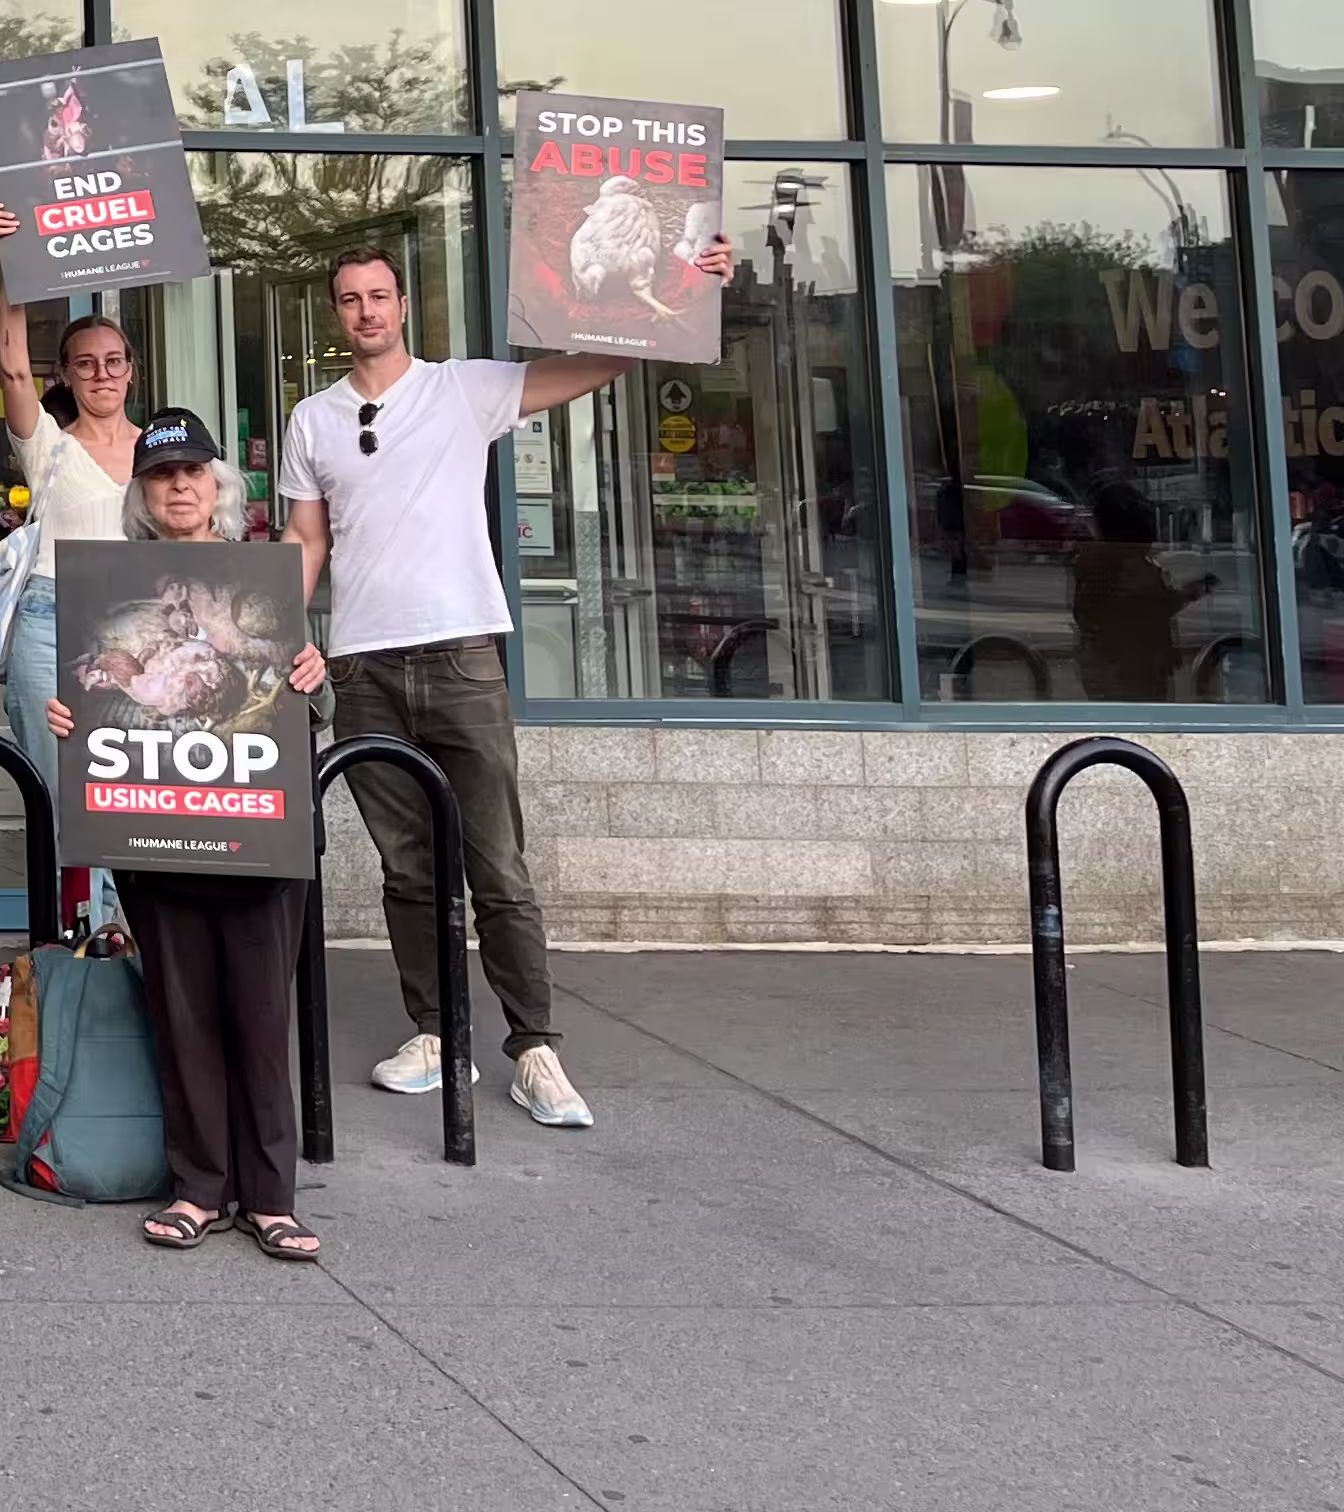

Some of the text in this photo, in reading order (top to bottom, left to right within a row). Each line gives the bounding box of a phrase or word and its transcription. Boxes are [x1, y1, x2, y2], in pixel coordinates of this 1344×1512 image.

[538, 111, 707, 146] STOP THIS
[529, 140, 708, 188] ABUSE
[53, 171, 122, 200] END
[42, 197, 148, 229] CRUEL
[46, 223, 154, 258] CAGES
[64, 261, 141, 279] HUMANE LEAGUE
[574, 332, 649, 347] HUMANE LEAGUE
[87, 726, 279, 784] STOP
[93, 787, 275, 814] USING CAGES
[133, 837, 228, 852] HUMANE LEAGUE
